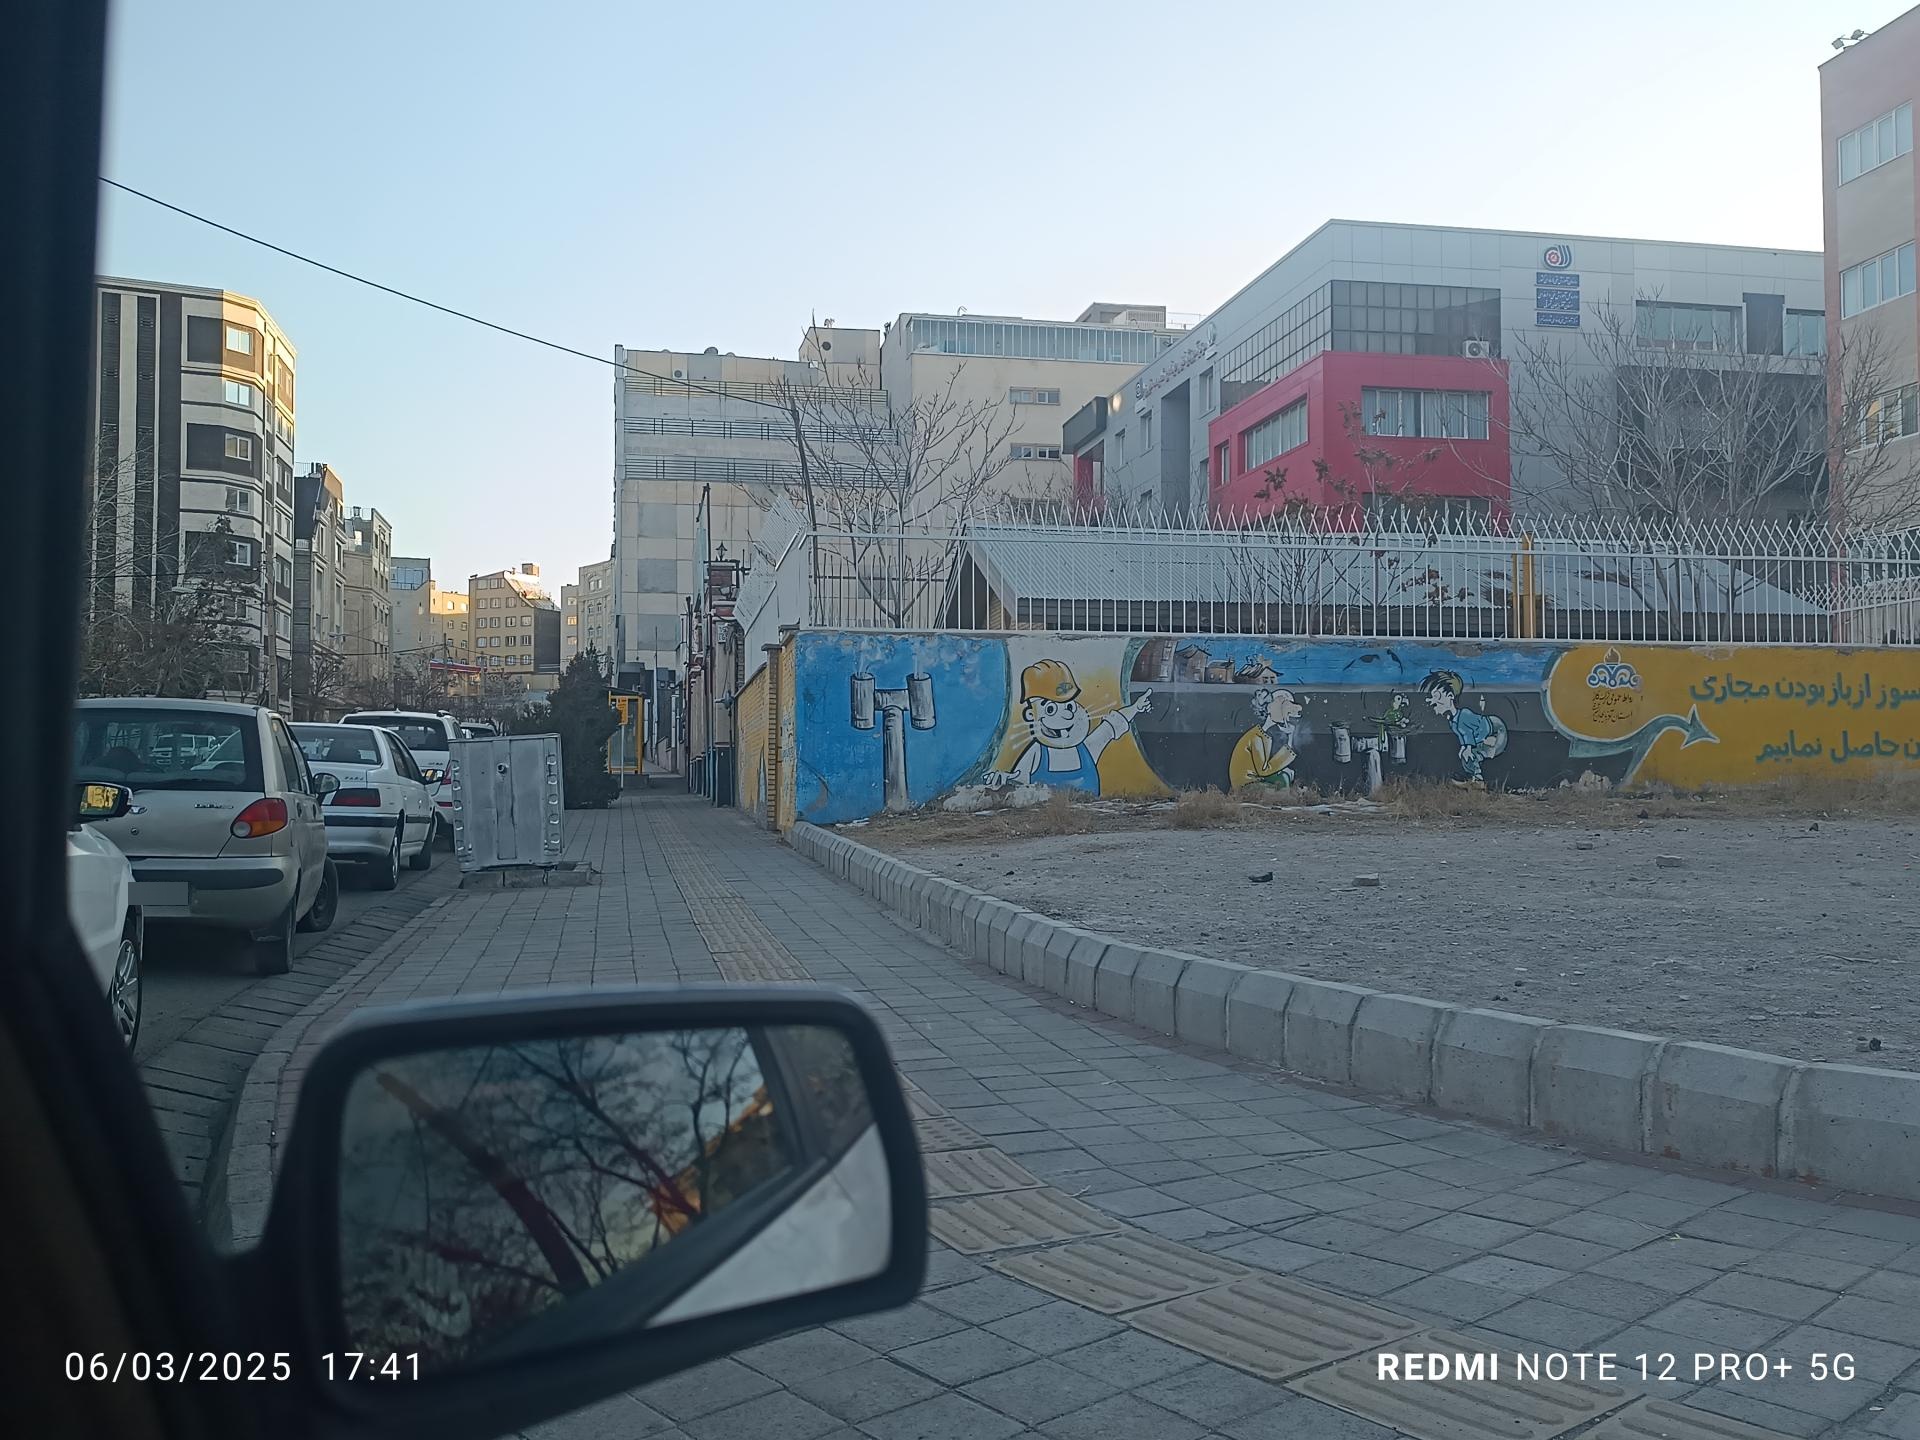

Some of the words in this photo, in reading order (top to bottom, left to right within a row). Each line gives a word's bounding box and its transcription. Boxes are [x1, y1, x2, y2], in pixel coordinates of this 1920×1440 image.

[1689, 672, 1770, 705] مجاری
[1774, 676, 1825, 708] بودن
[1827, 671, 1852, 708] باز
[1851, 673, 1871, 710] از
[1829, 729, 1899, 764] حاصل
